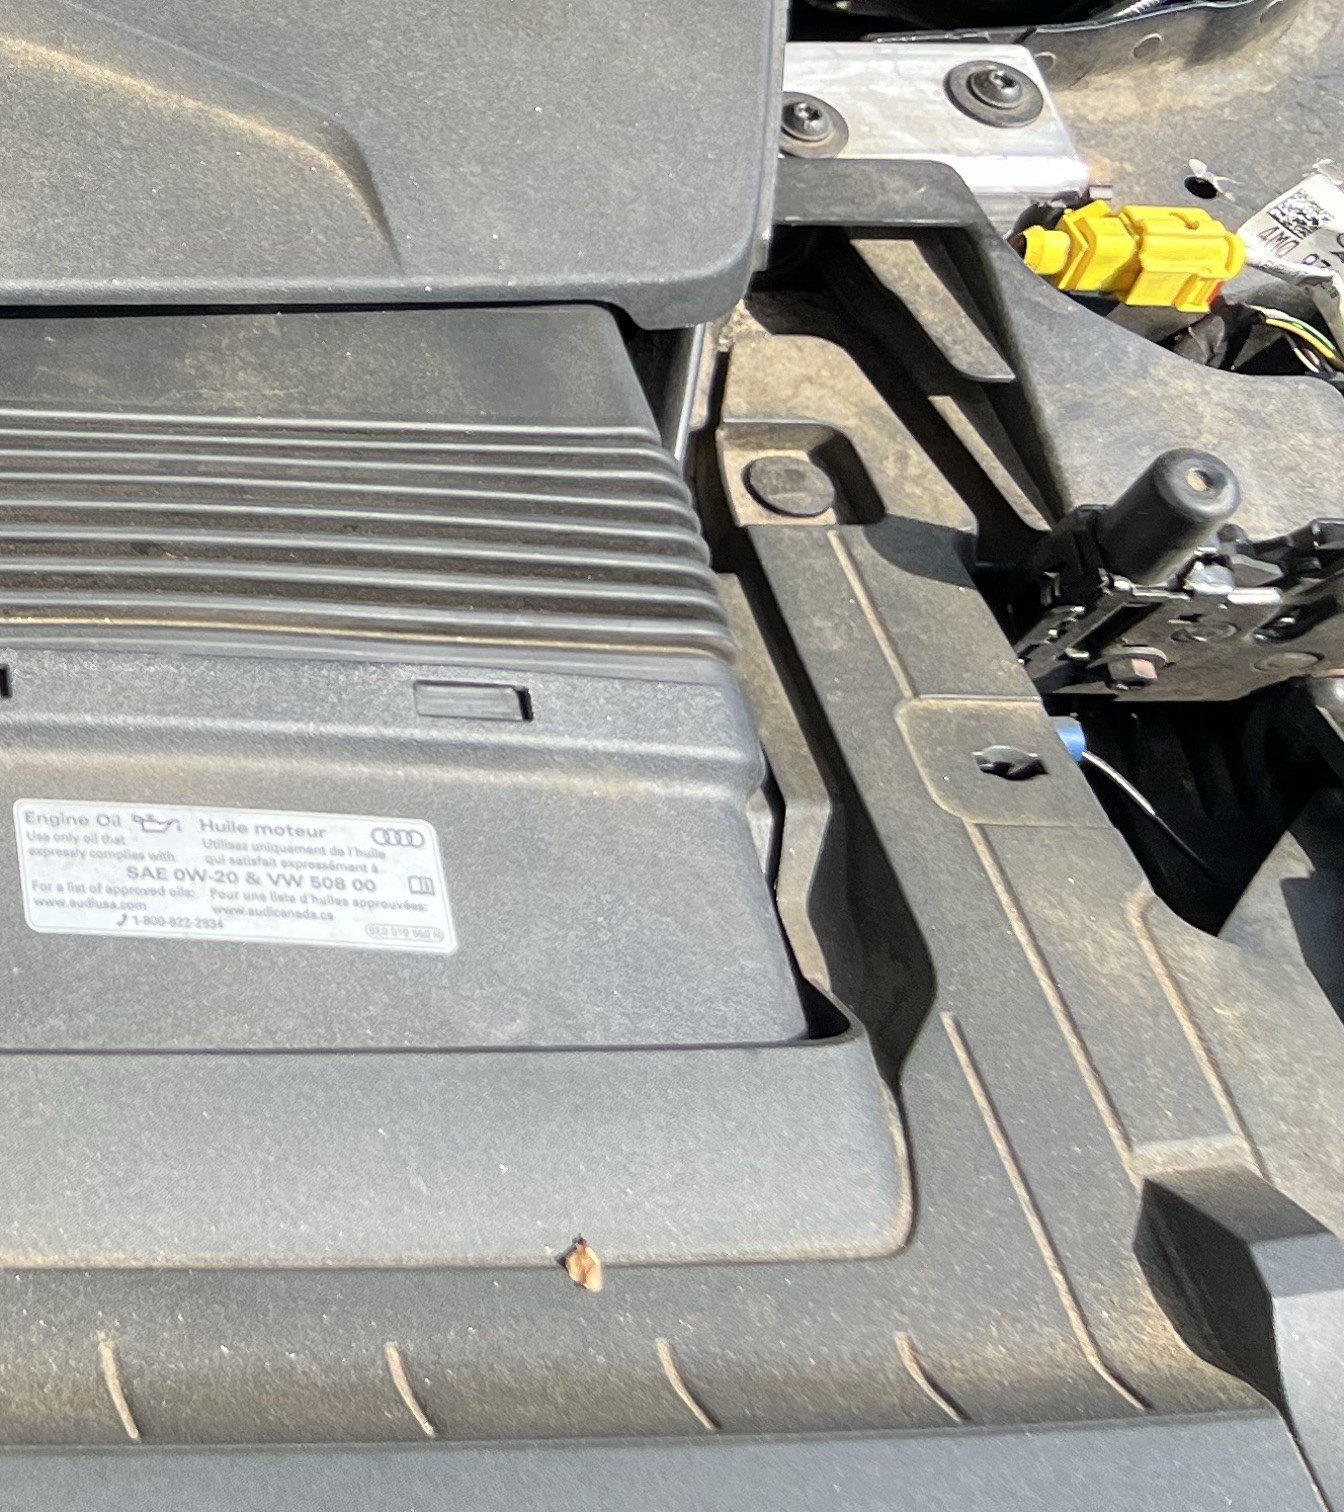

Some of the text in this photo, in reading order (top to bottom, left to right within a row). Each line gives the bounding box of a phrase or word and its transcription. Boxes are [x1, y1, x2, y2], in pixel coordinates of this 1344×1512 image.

[25, 811, 121, 828] Engine Oil
[199, 818, 327, 838] Huile moteur
[26, 830, 126, 845] Use only oil that
[28, 848, 175, 863] expressly complies with
[251, 842, 326, 856] uniquement
[329, 846, 345, 857] de
[205, 854, 226, 866] qui
[126, 865, 377, 892] SAE 0W-20 & VW 508 00
[31, 880, 52, 892] For
[67, 881, 86, 894] list
[89, 882, 102, 894] of
[105, 885, 166, 898] approved
[210, 888, 239, 900] Pour
[242, 892, 267, 902] une
[270, 891, 296, 903] liste
